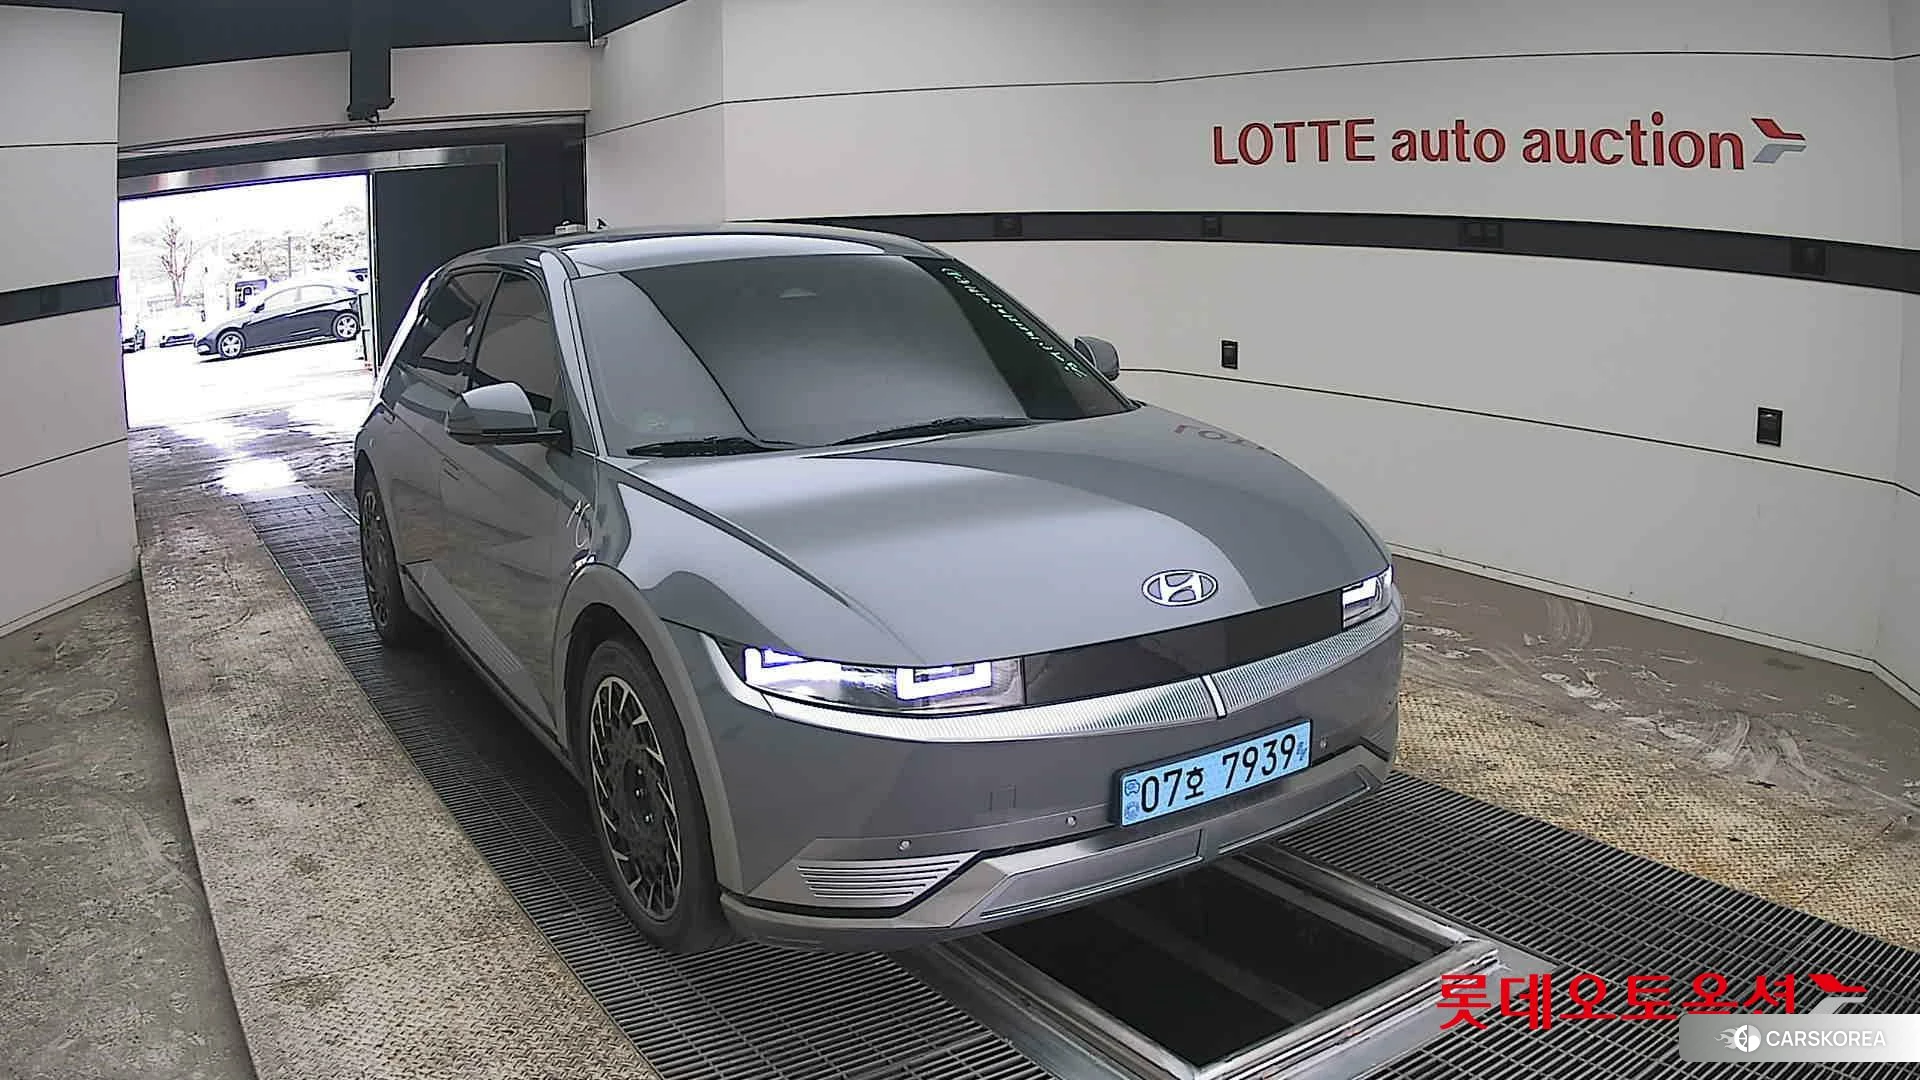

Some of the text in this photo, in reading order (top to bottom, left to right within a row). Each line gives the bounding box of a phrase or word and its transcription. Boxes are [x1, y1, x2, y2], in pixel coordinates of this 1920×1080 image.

[1212, 111, 1745, 170] LOTTE auto auction
[1141, 733, 1296, 813] 07호 7939
